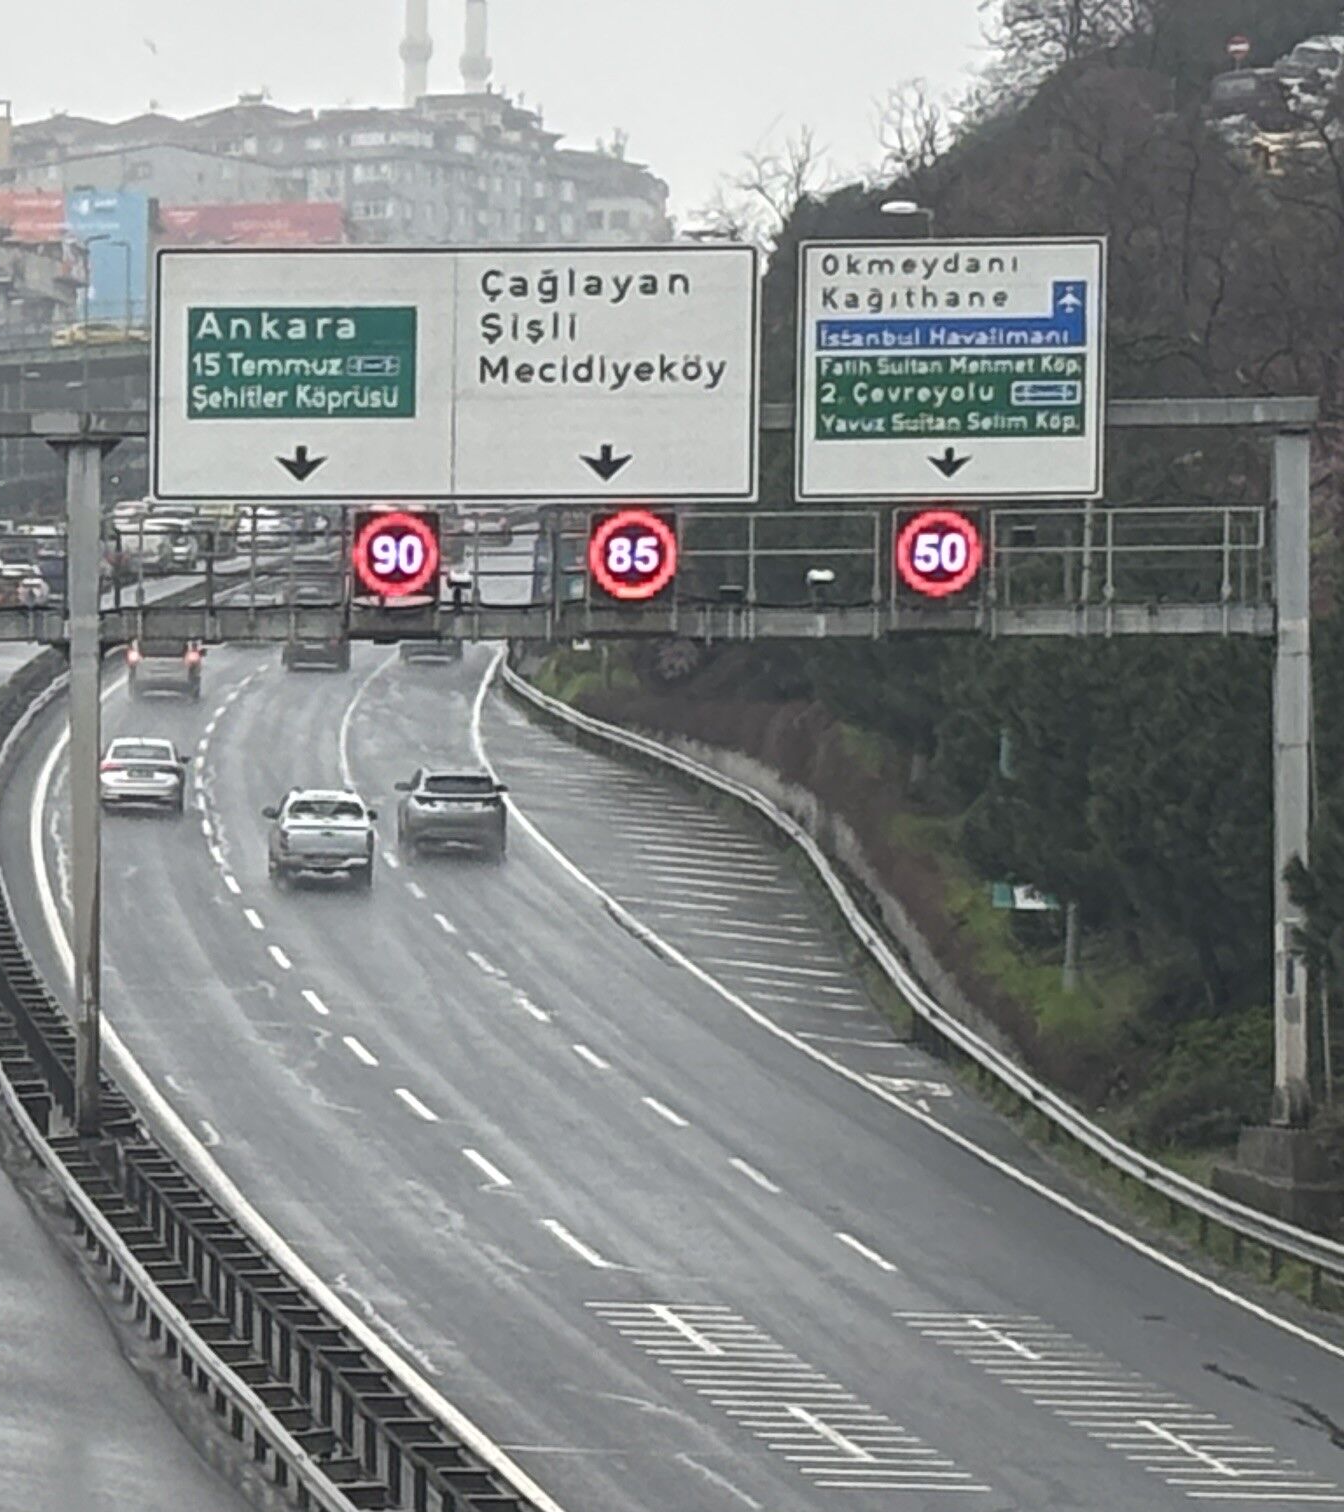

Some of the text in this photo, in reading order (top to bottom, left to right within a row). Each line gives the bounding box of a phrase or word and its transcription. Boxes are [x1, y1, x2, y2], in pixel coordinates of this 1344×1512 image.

[821, 253, 1018, 280] Okmeydanı
[480, 267, 690, 304] Çağlayan
[821, 286, 1009, 313] Kağıthane
[196, 312, 356, 340] Ankara
[481, 311, 577, 344] Şişli
[192, 352, 343, 377] 15 Temmuz
[479, 353, 727, 390] Mecidiyeköy
[820, 357, 872, 377] Fatih
[877, 357, 943, 375] Sultan
[949, 356, 1034, 375] Mehmet
[192, 384, 398, 414] Şehitler Köprüsü
[853, 381, 994, 408] Çevreyolu
[820, 413, 886, 432] Yavuz
[892, 412, 961, 432] Sultan
[967, 412, 1028, 432] Selim
[372, 534, 423, 574] 90
[608, 536, 659, 574] 85
[915, 533, 965, 572] 50
